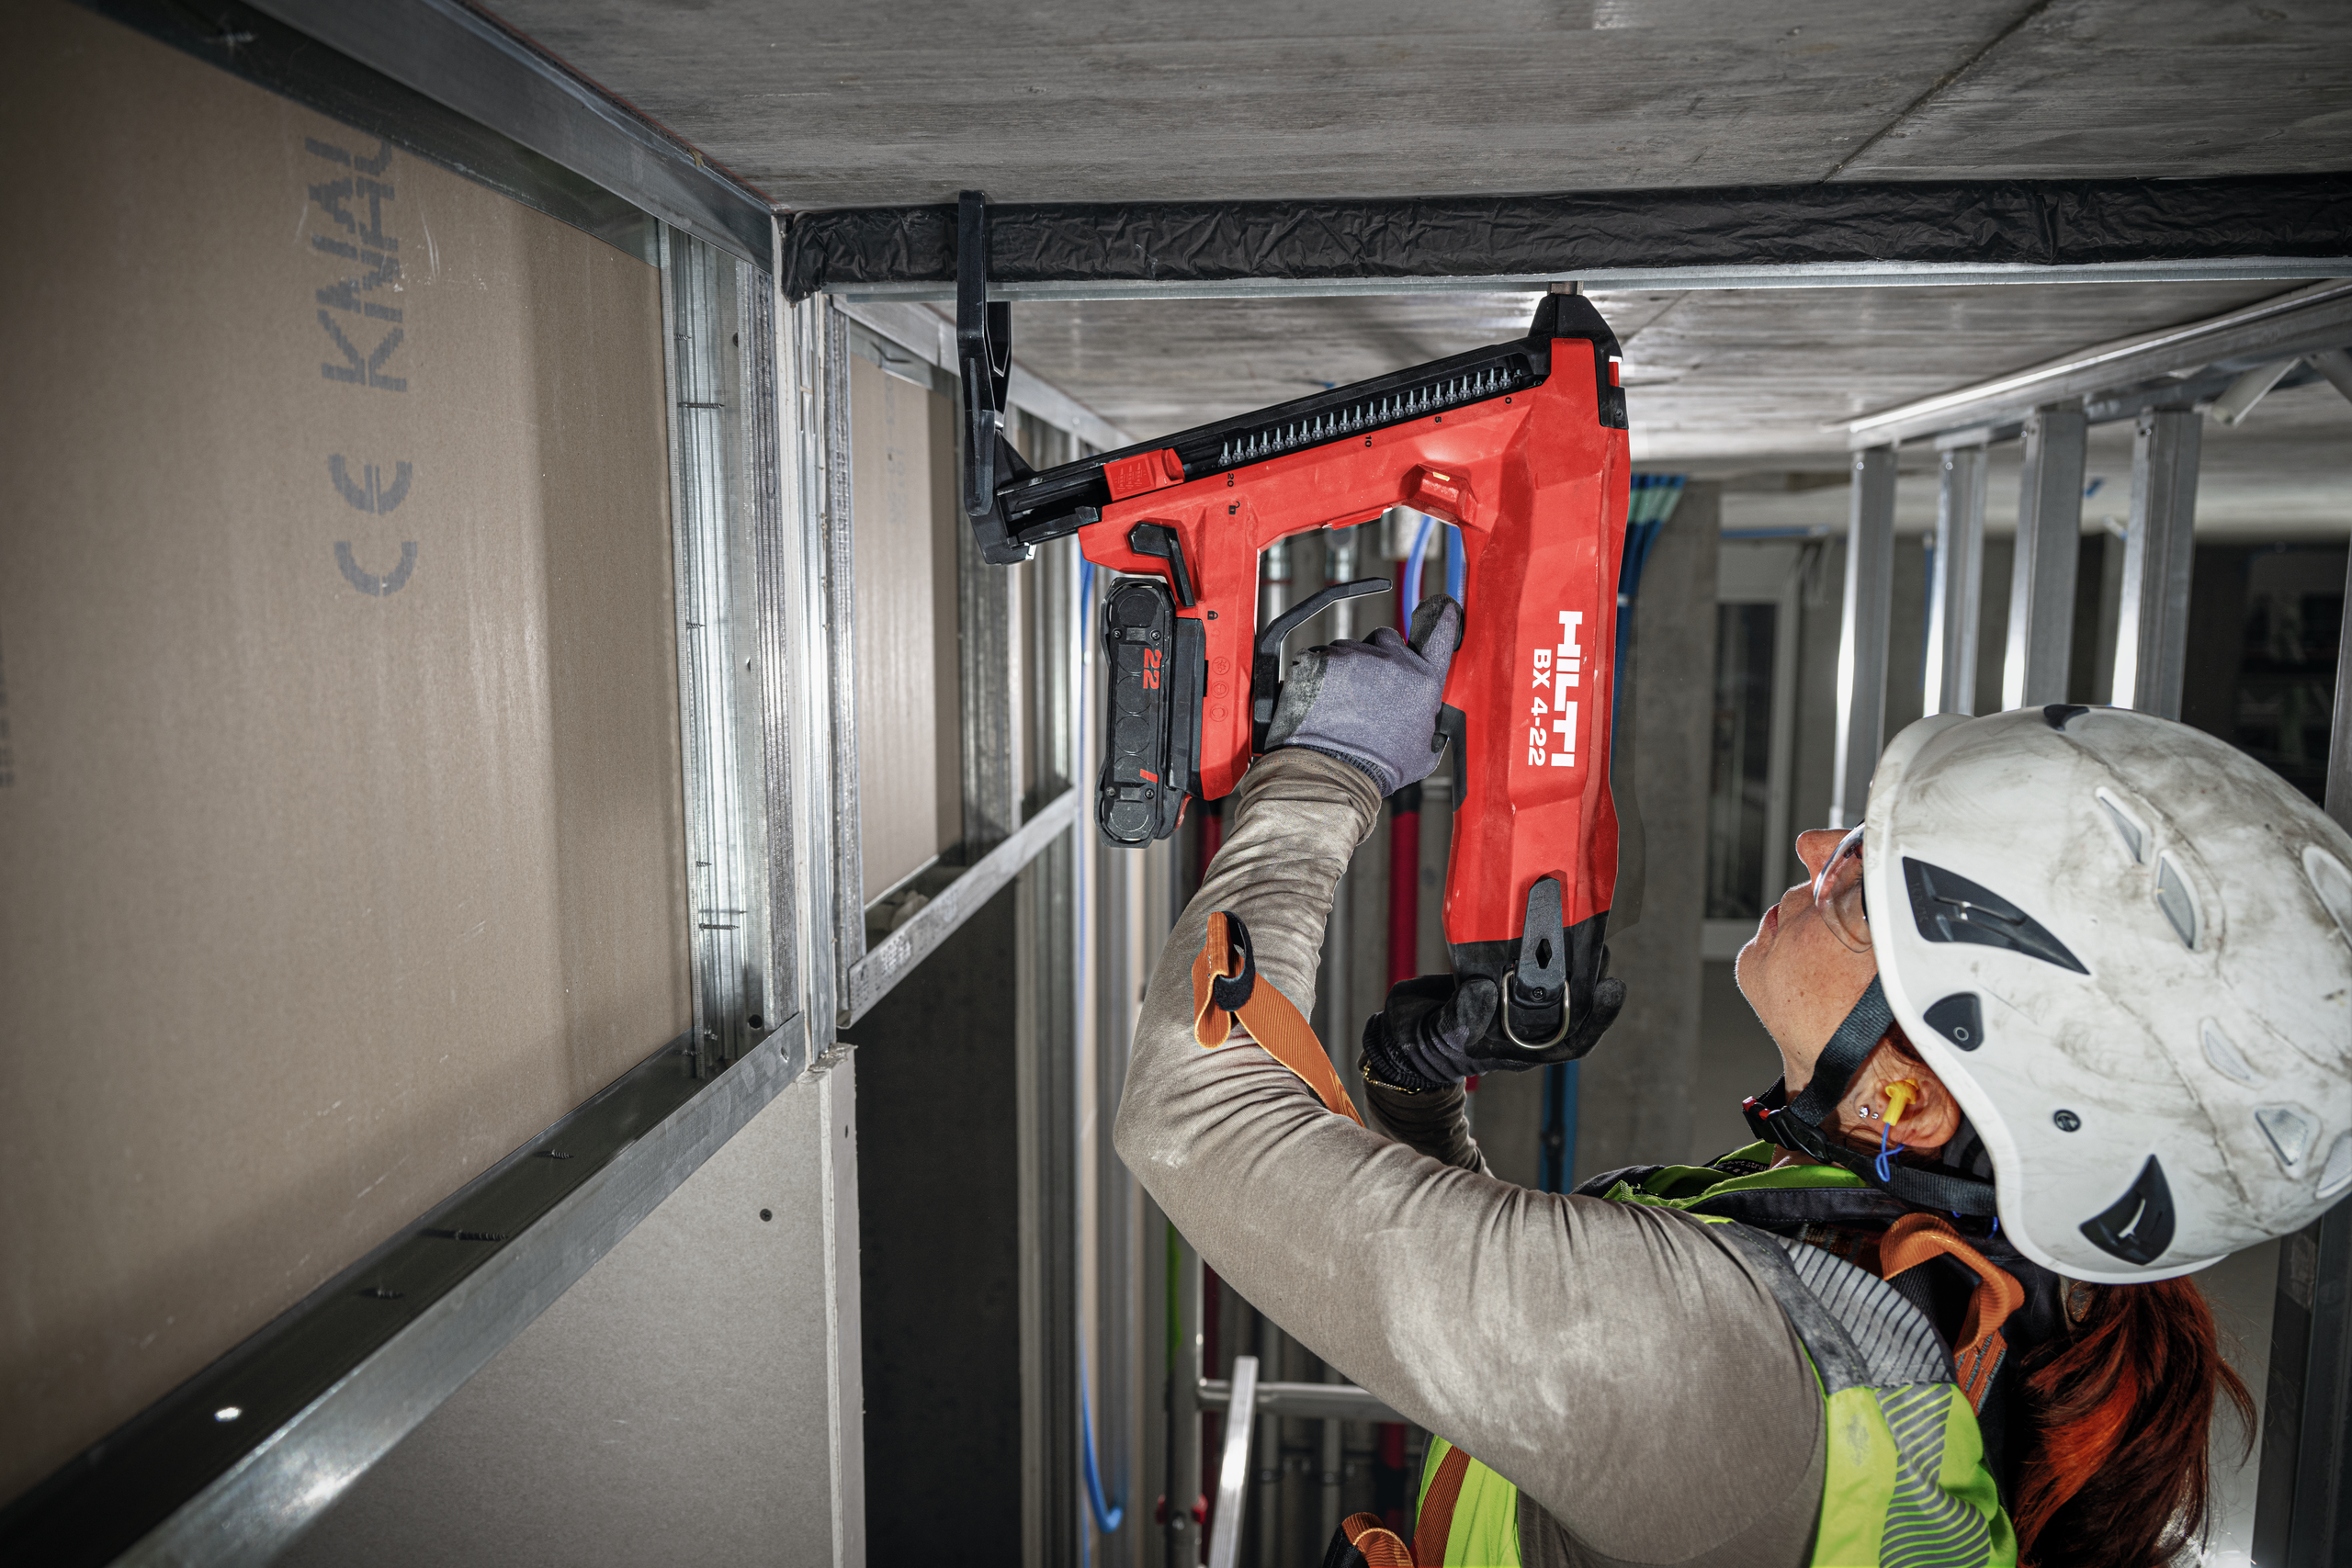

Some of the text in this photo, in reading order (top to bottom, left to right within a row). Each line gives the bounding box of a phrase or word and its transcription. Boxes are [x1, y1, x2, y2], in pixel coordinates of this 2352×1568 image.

[1504, 396, 1513, 405] 0
[1434, 415, 1442, 424] 5
[1363, 434, 1373, 448] 10
[1227, 472, 1235, 488] 20
[1142, 648, 1163, 691] 22
[1551, 610, 1583, 767] HILTI
[1528, 649, 1552, 767] BX 4-22
